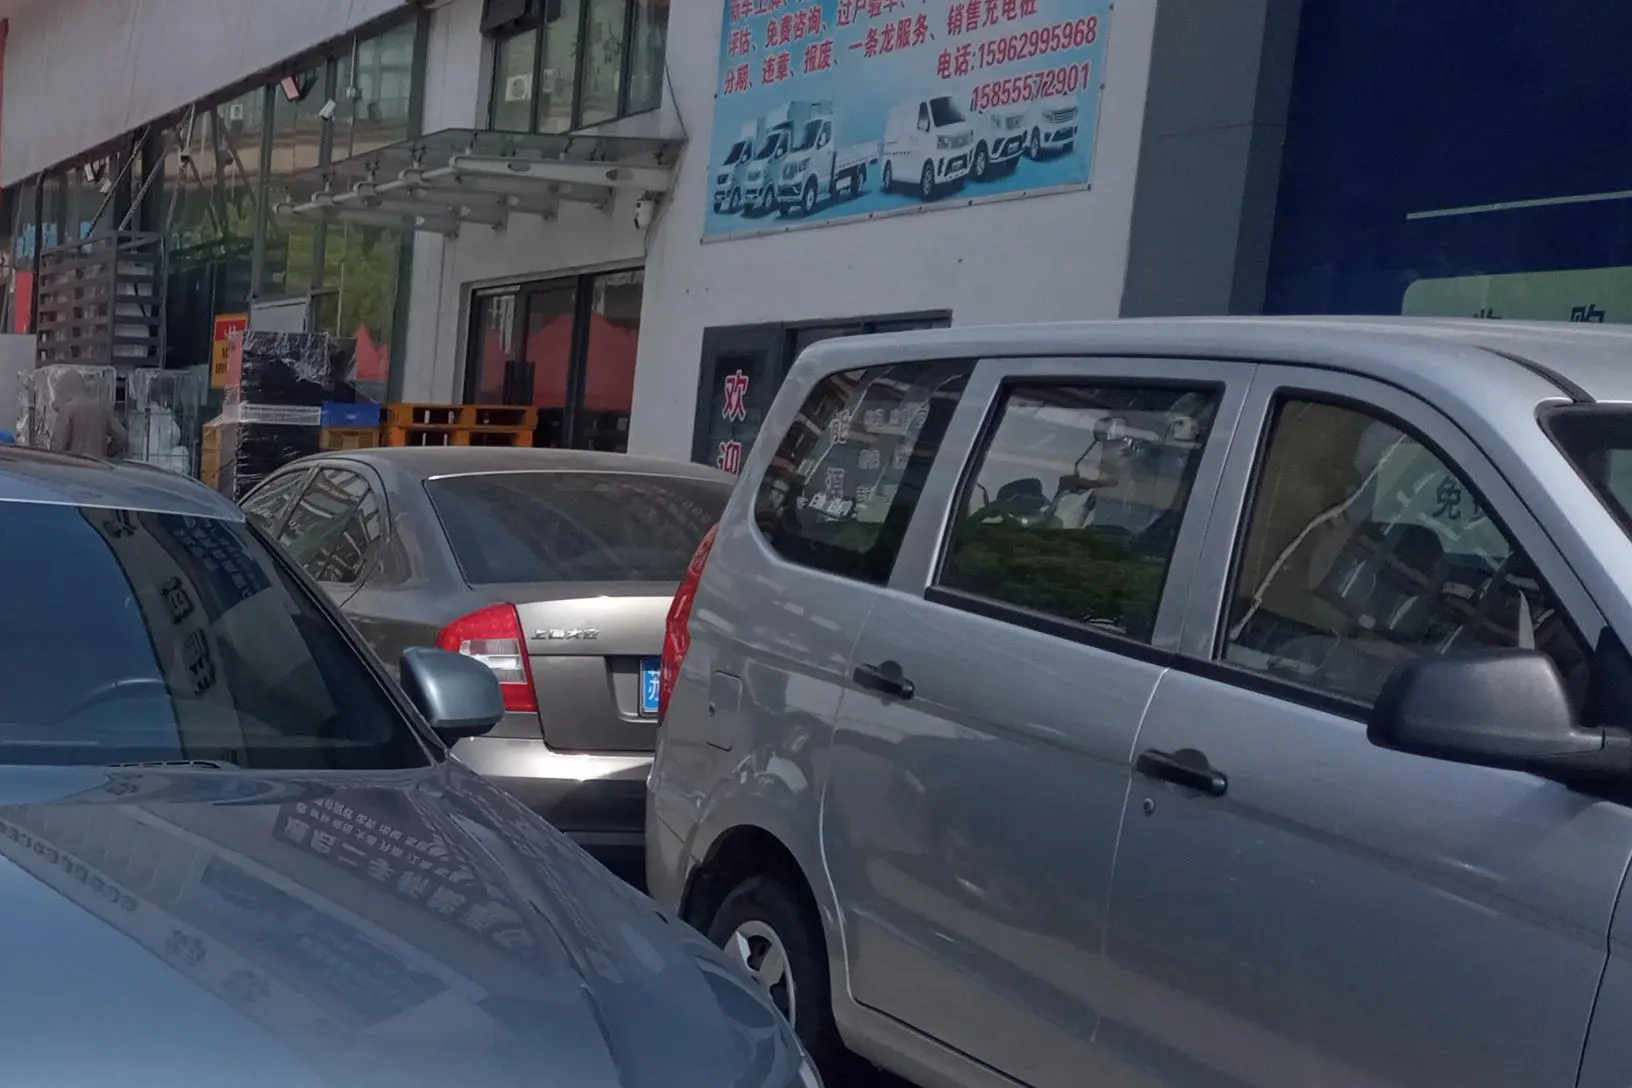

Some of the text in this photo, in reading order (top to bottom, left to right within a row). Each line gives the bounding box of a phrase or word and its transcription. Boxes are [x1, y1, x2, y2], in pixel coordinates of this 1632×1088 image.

[970, 63, 1090, 112] 15855572901
[530, 628, 601, 640] 上海大众
